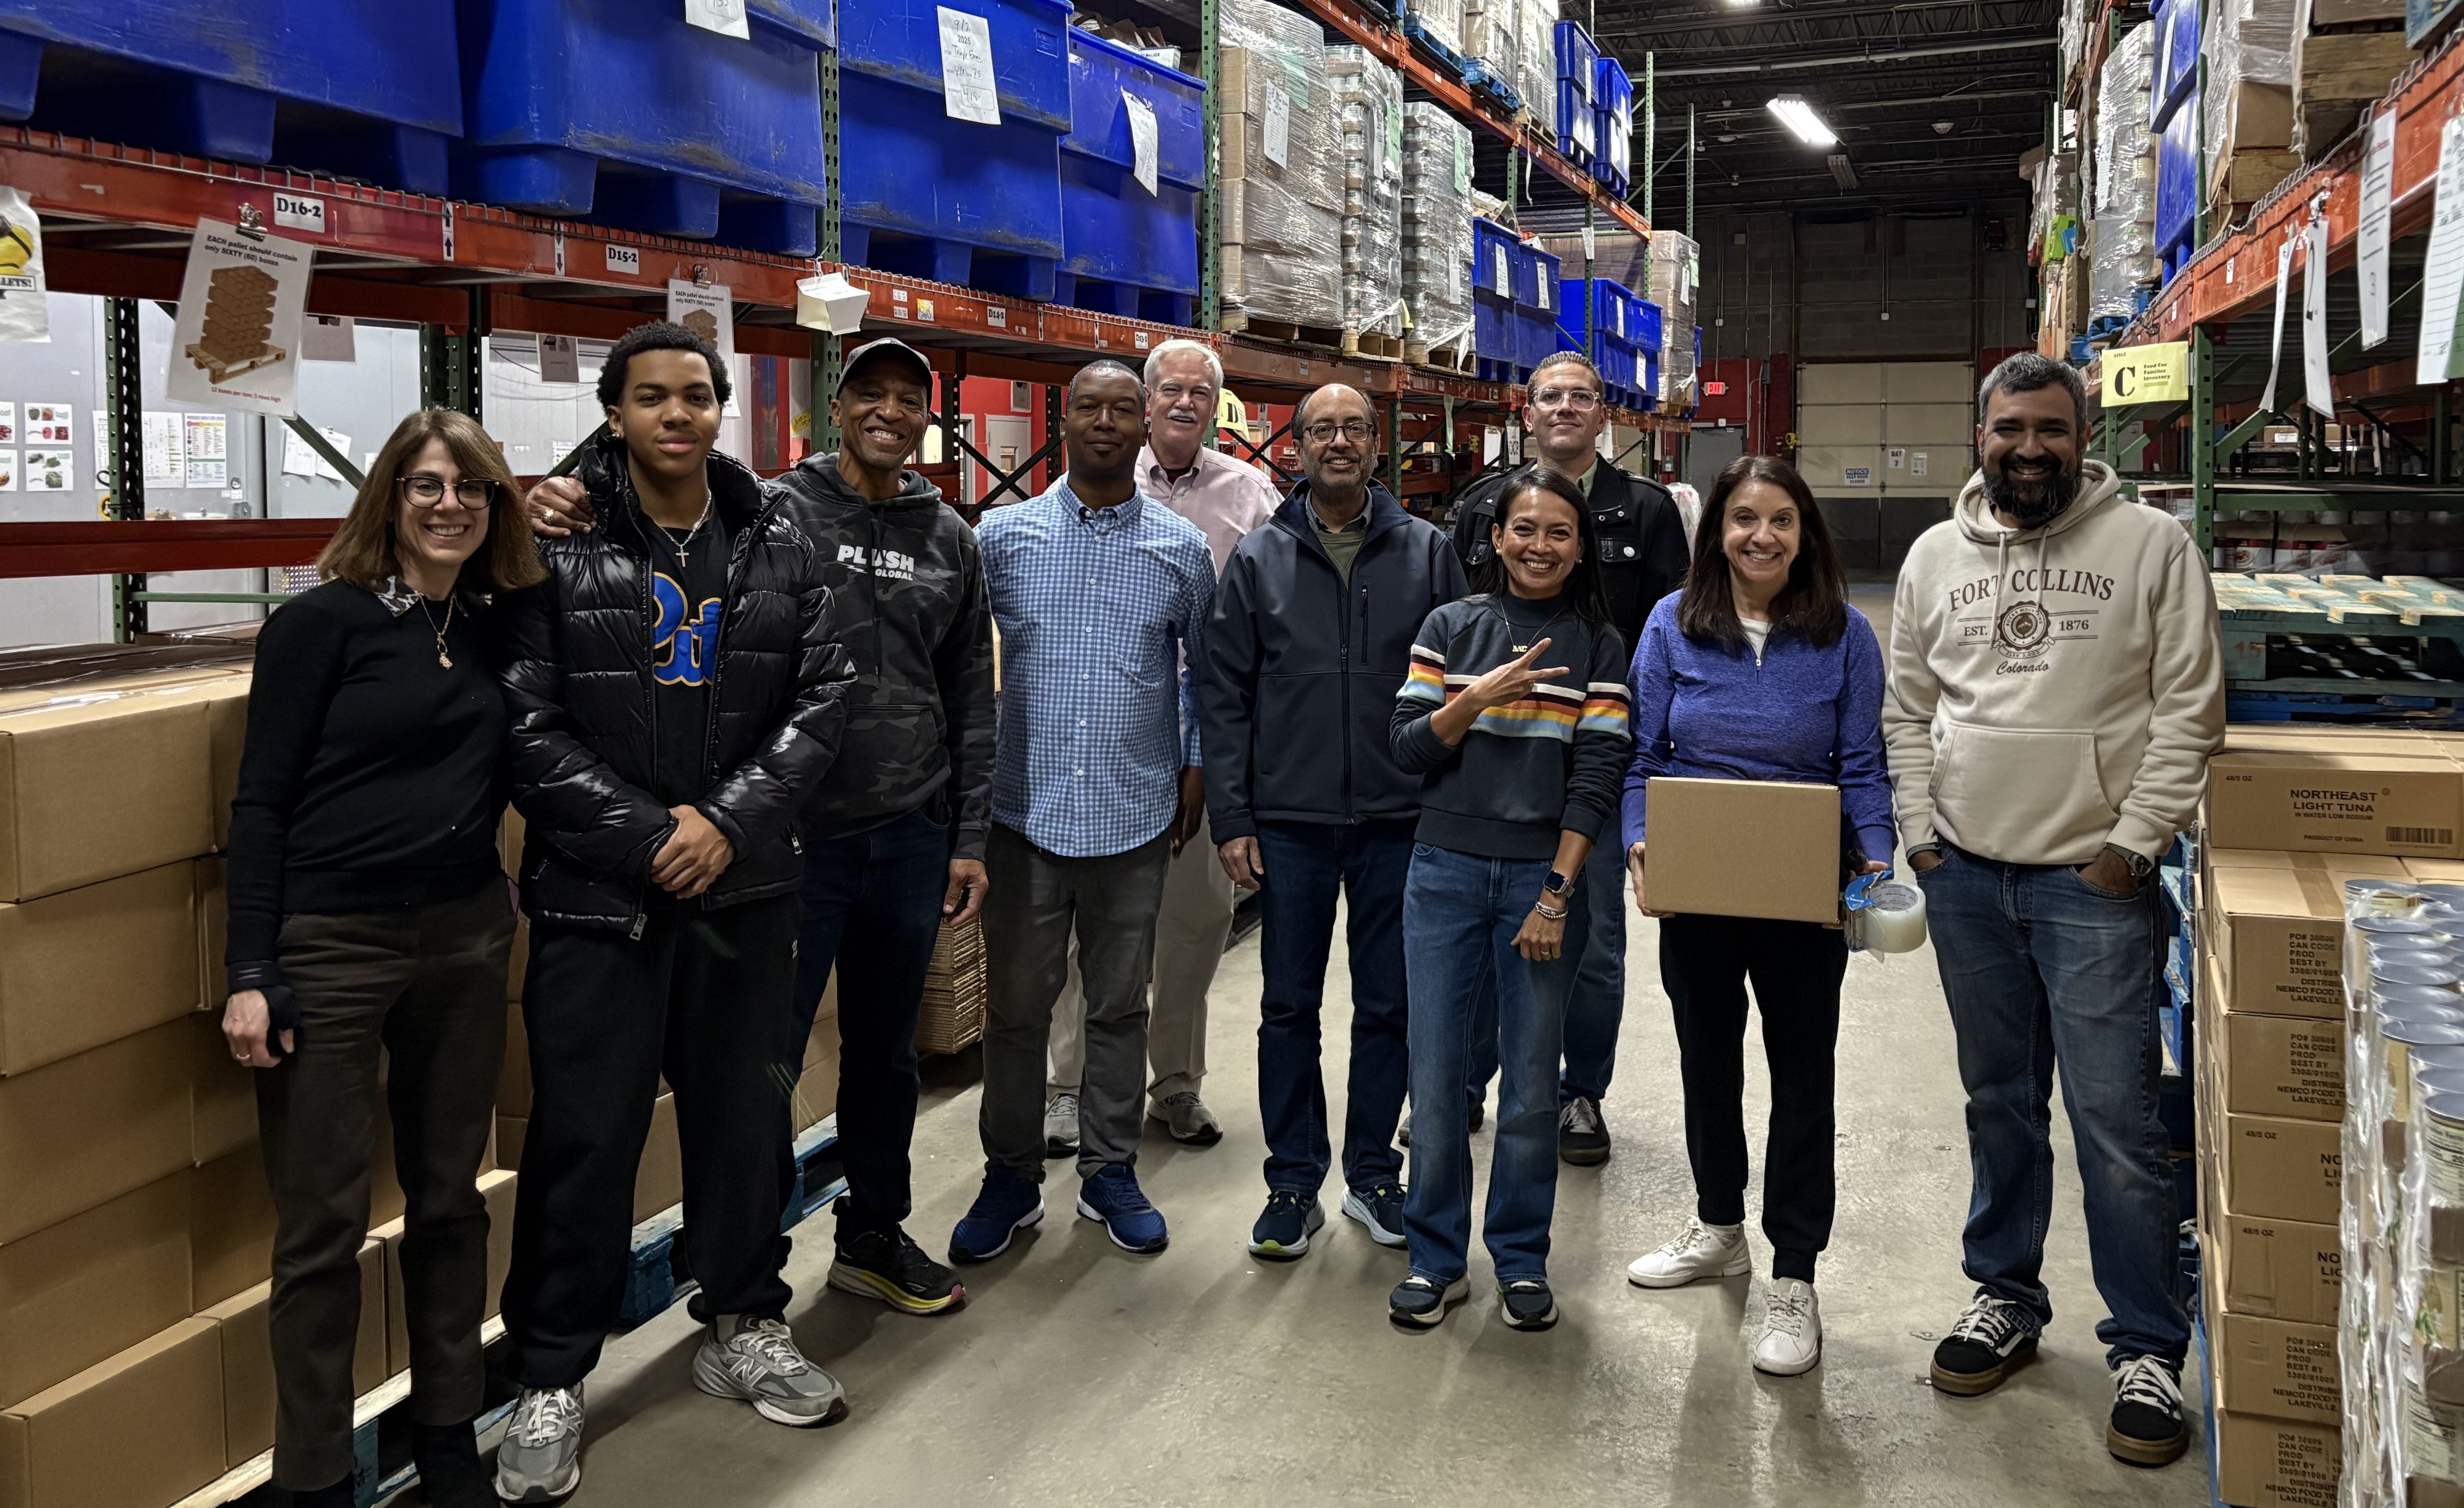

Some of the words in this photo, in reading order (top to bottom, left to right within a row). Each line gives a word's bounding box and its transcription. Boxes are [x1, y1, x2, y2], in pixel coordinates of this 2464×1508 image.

[957, 34, 971, 45] 2025
[276, 197, 321, 218] D16-2
[207, 235, 227, 244] EACH
[228, 241, 248, 250] pallet
[249, 246, 271, 255] should
[273, 252, 297, 262] contain
[204, 244, 219, 253] only
[221, 248, 243, 258] SIXTY
[259, 257, 279, 266] boxes
[608, 247, 637, 263] D15-2
[0, 277, 32, 287] LETS!
[2115, 366, 2135, 397] C
[1709, 384, 1723, 393] EXIT
[1227, 402, 1238, 423] D
[837, 545, 914, 572] PLUSH
[875, 569, 913, 581] GLOBAL
[2011, 569, 2115, 601] COLLINS
[2006, 611, 2018, 626] ROCKY
[1964, 626, 1988, 636] EST.
[2059, 620, 2089, 631] 1876
[1997, 661, 2049, 675] Colorado
[2290, 789, 2378, 802] NORTHEAST
[2293, 802, 2333, 811] LIGHT
[2339, 803, 2374, 812] TUNA
[2276, 985, 2308, 993] NEMCO
[2301, 979, 2343, 988] DISTRIBU
[2311, 1044, 2337, 1053] CODE
[2302, 1079, 2345, 1089] DISTRIBU
[2277, 1086, 2309, 1095] NEMCO
[2311, 1089, 2336, 1097] FOOD
[2287, 1346, 2304, 1354] CAN
[2307, 1348, 2332, 1358] CODE
[2287, 1354, 2311, 1363] PROD
[2287, 1362, 2308, 1371] BEST
[2298, 1383, 2341, 1394] DISTRIBU
[2273, 1388, 2305, 1398] NEMCO
[2307, 1393, 2330, 1402] FOOD
[2278, 1442, 2296, 1450] CAN
[2299, 1445, 2323, 1454] CODE
[2278, 1450, 2303, 1459] PROD
[2278, 1458, 2301, 1466] BEST
[2266, 1484, 2297, 1494] NEMCO
[2299, 1489, 2322, 1498] FOOD
[2290, 1479, 2338, 1492] DISTRIBUT
